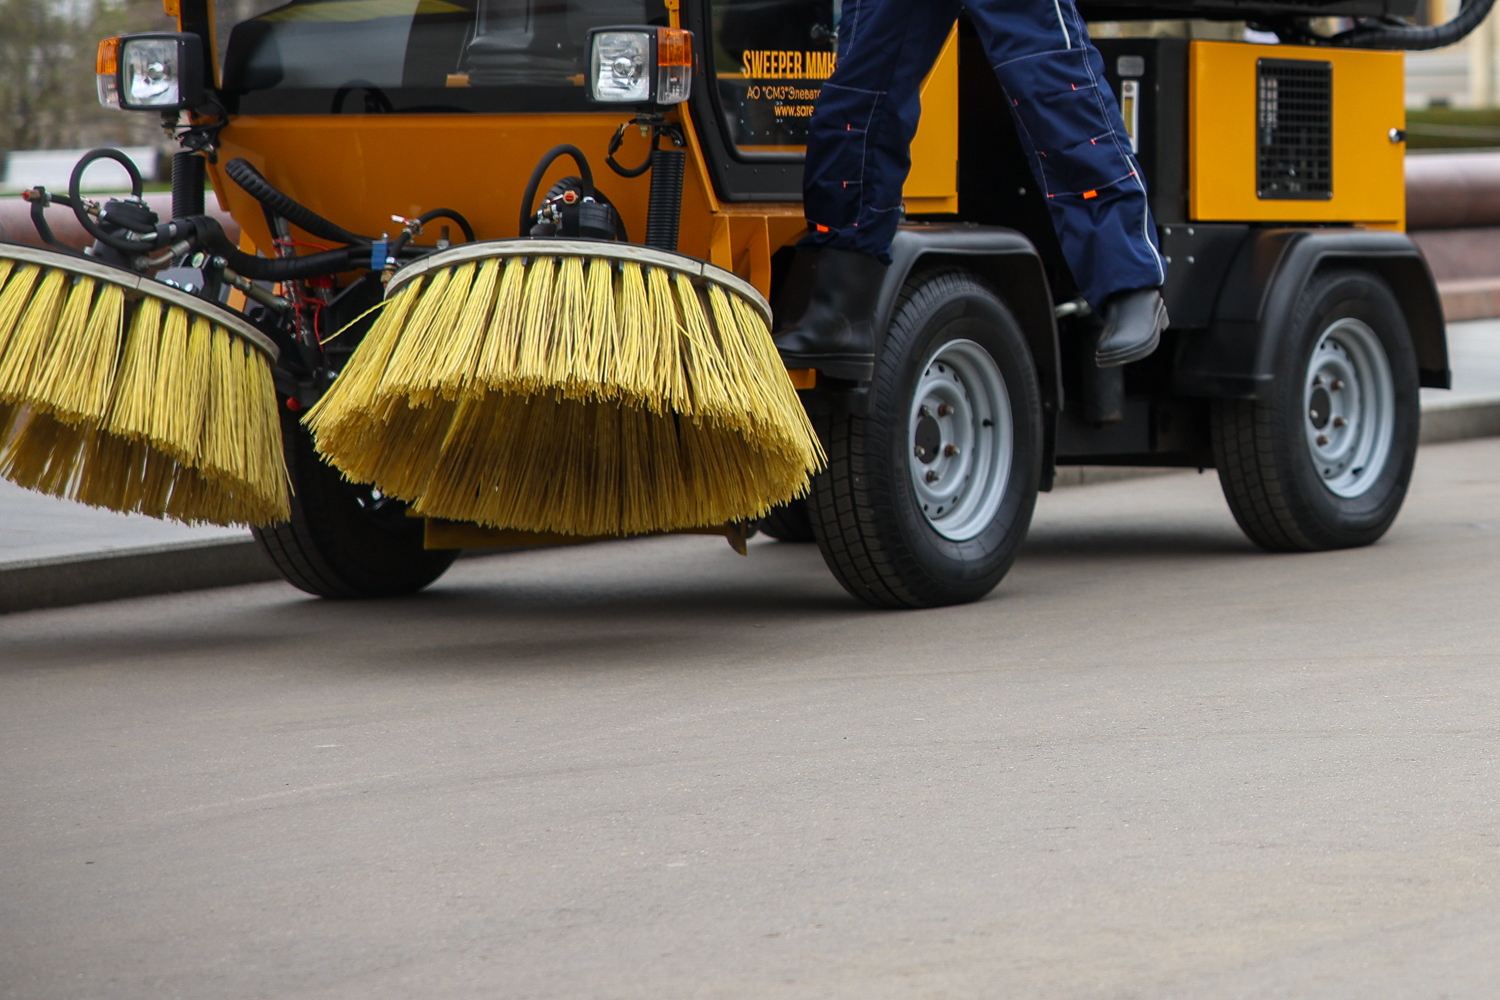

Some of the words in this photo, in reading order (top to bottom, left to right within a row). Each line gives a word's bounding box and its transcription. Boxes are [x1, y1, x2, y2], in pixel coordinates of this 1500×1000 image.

[743, 50, 802, 79] SWEEPER
[806, 51, 838, 79] MMK
[746, 86, 761, 100] АО
[762, 86, 821, 100] "СМЗ"Элеват
[774, 105, 814, 117] www.sare
